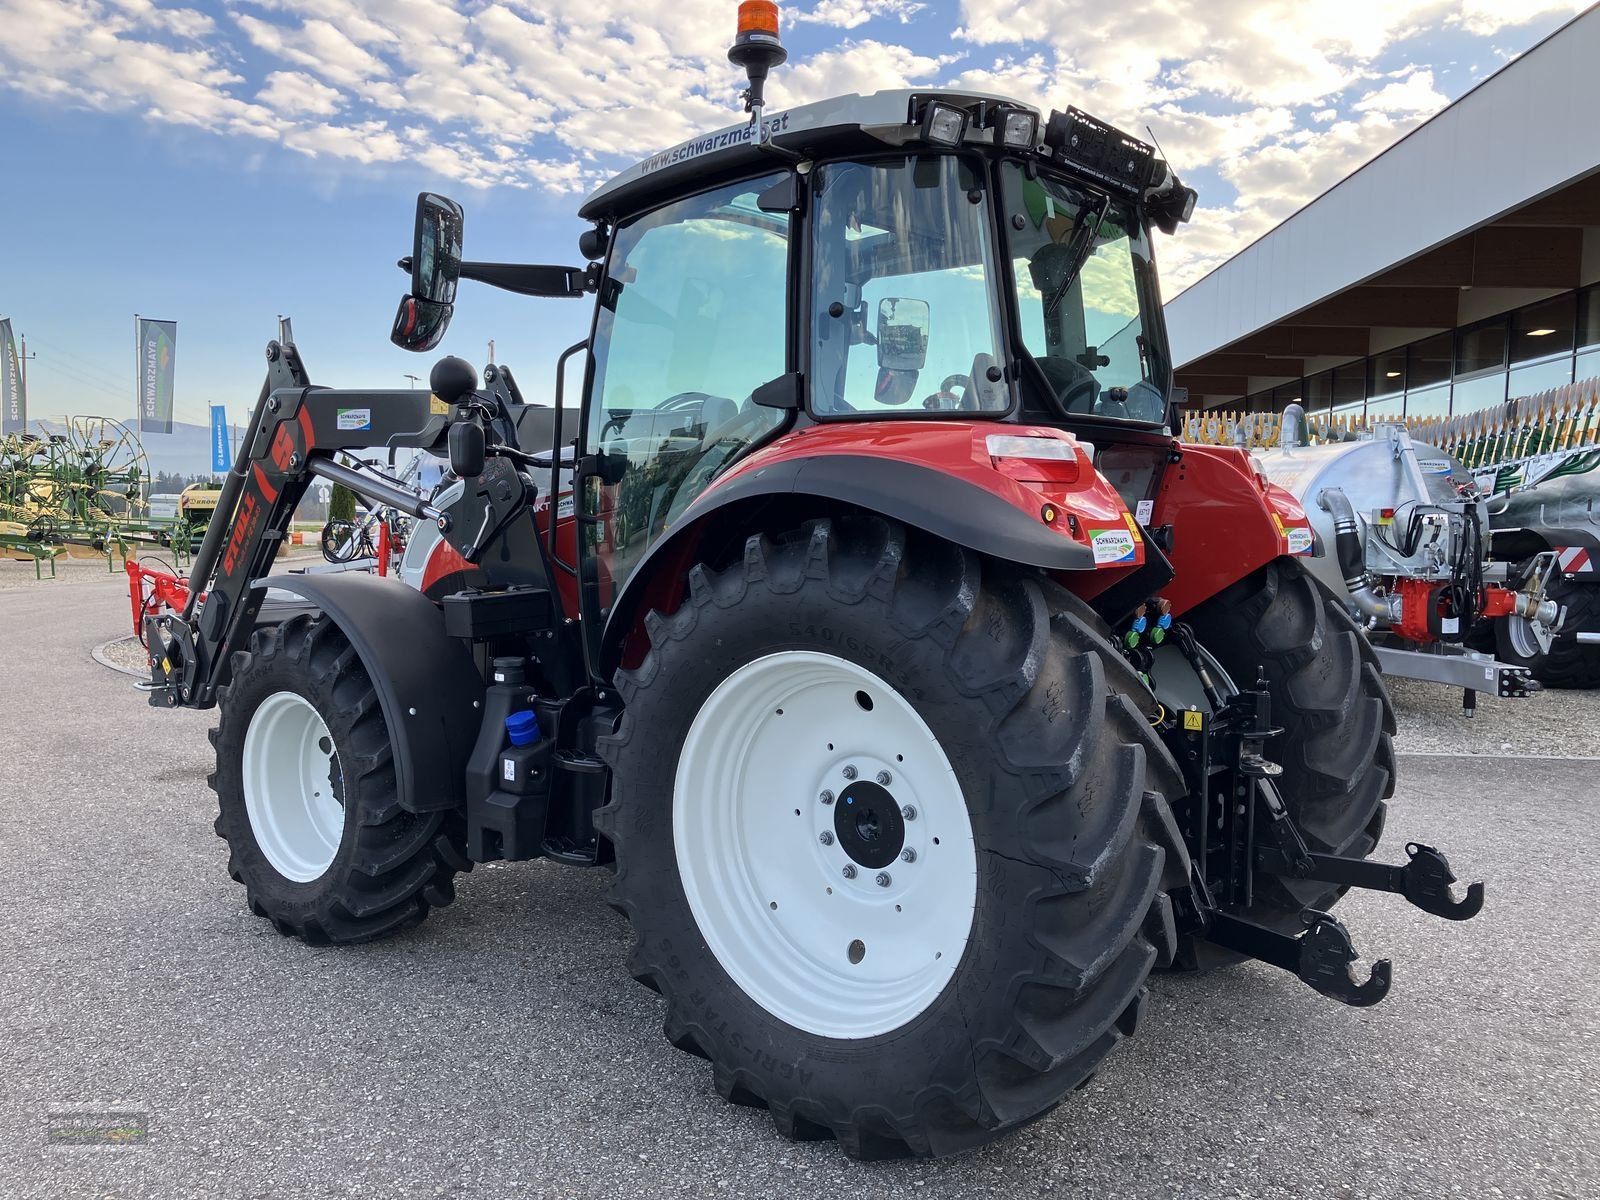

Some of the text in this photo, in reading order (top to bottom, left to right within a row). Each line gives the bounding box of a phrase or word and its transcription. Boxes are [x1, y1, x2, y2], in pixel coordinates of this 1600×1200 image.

[641, 111, 789, 174] www.schwarzmaat
[8, 342, 19, 421] SCHWARZMAYR
[147, 340, 157, 418] SCHWARZMAYR
[224, 492, 255, 576] STOLL
